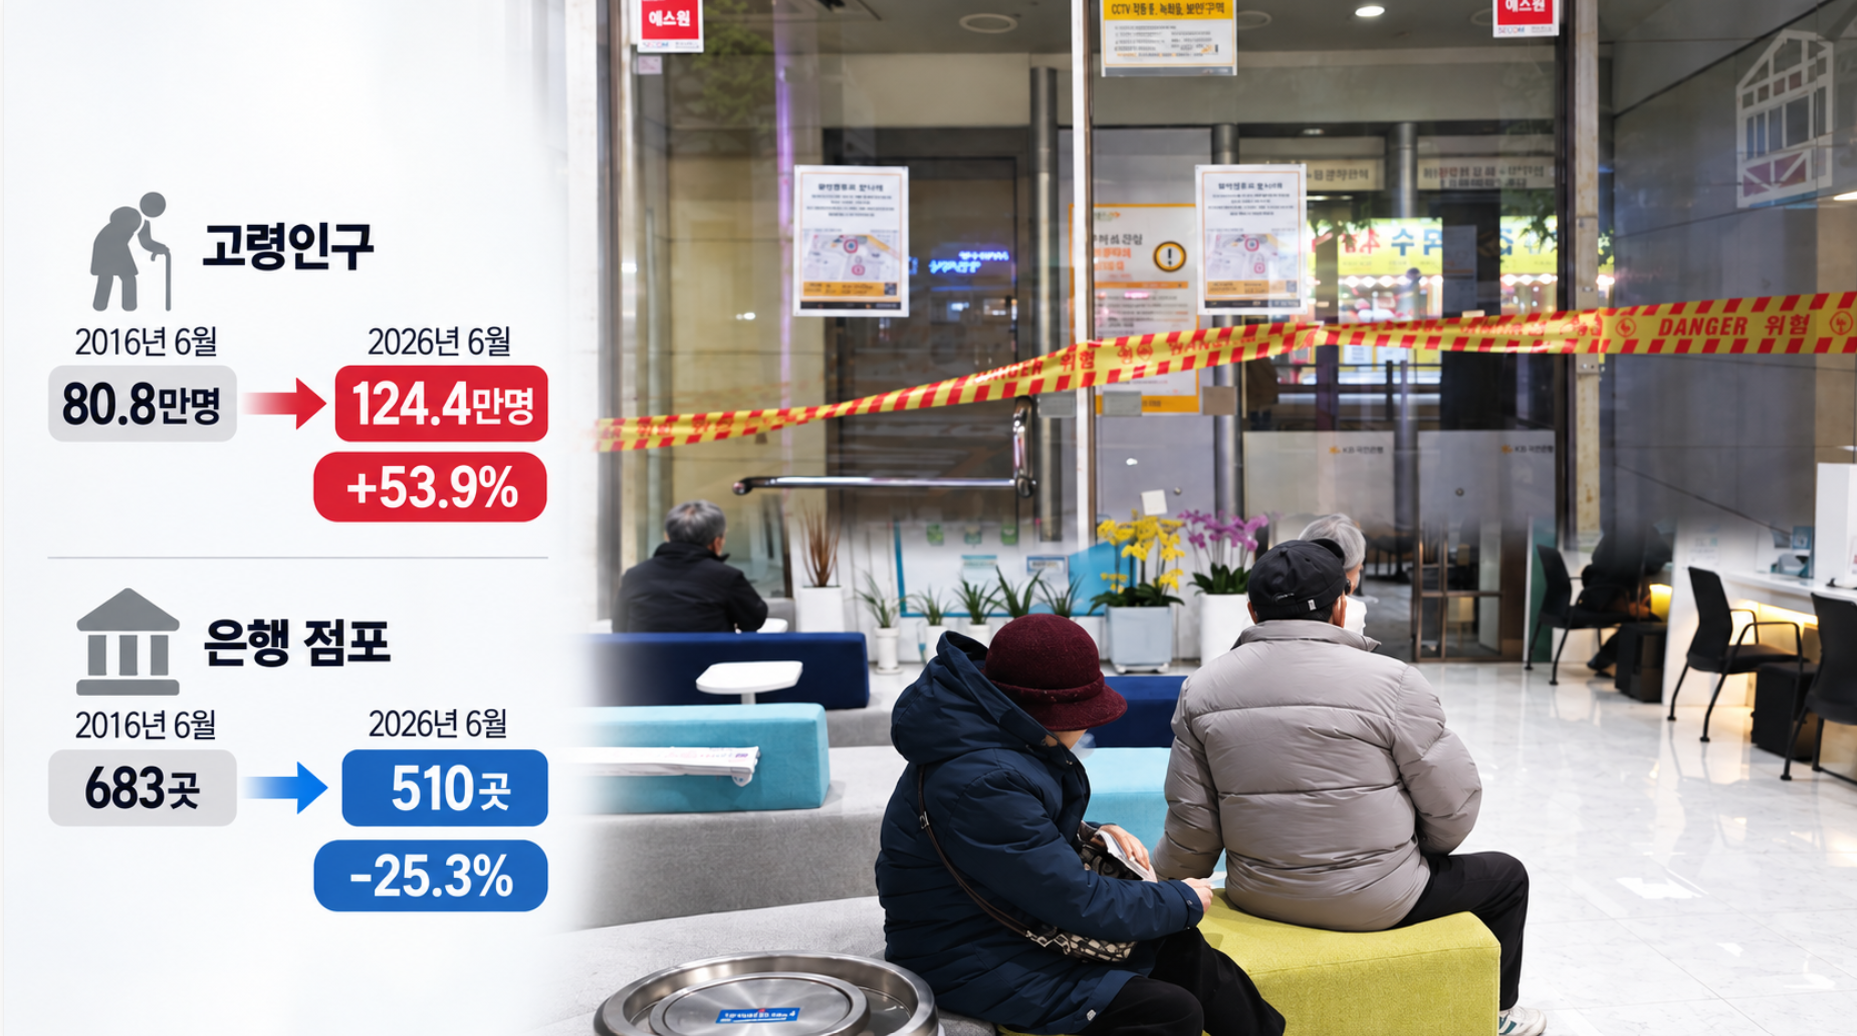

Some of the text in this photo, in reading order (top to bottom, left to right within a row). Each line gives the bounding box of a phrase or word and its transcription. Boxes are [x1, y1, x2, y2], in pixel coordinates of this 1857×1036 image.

[648, 9, 691, 27] 에스원
[1111, 4, 1131, 15] CCTV
[1658, 314, 1811, 337] DANGER 위험
[1061, 350, 1095, 372] 위험
